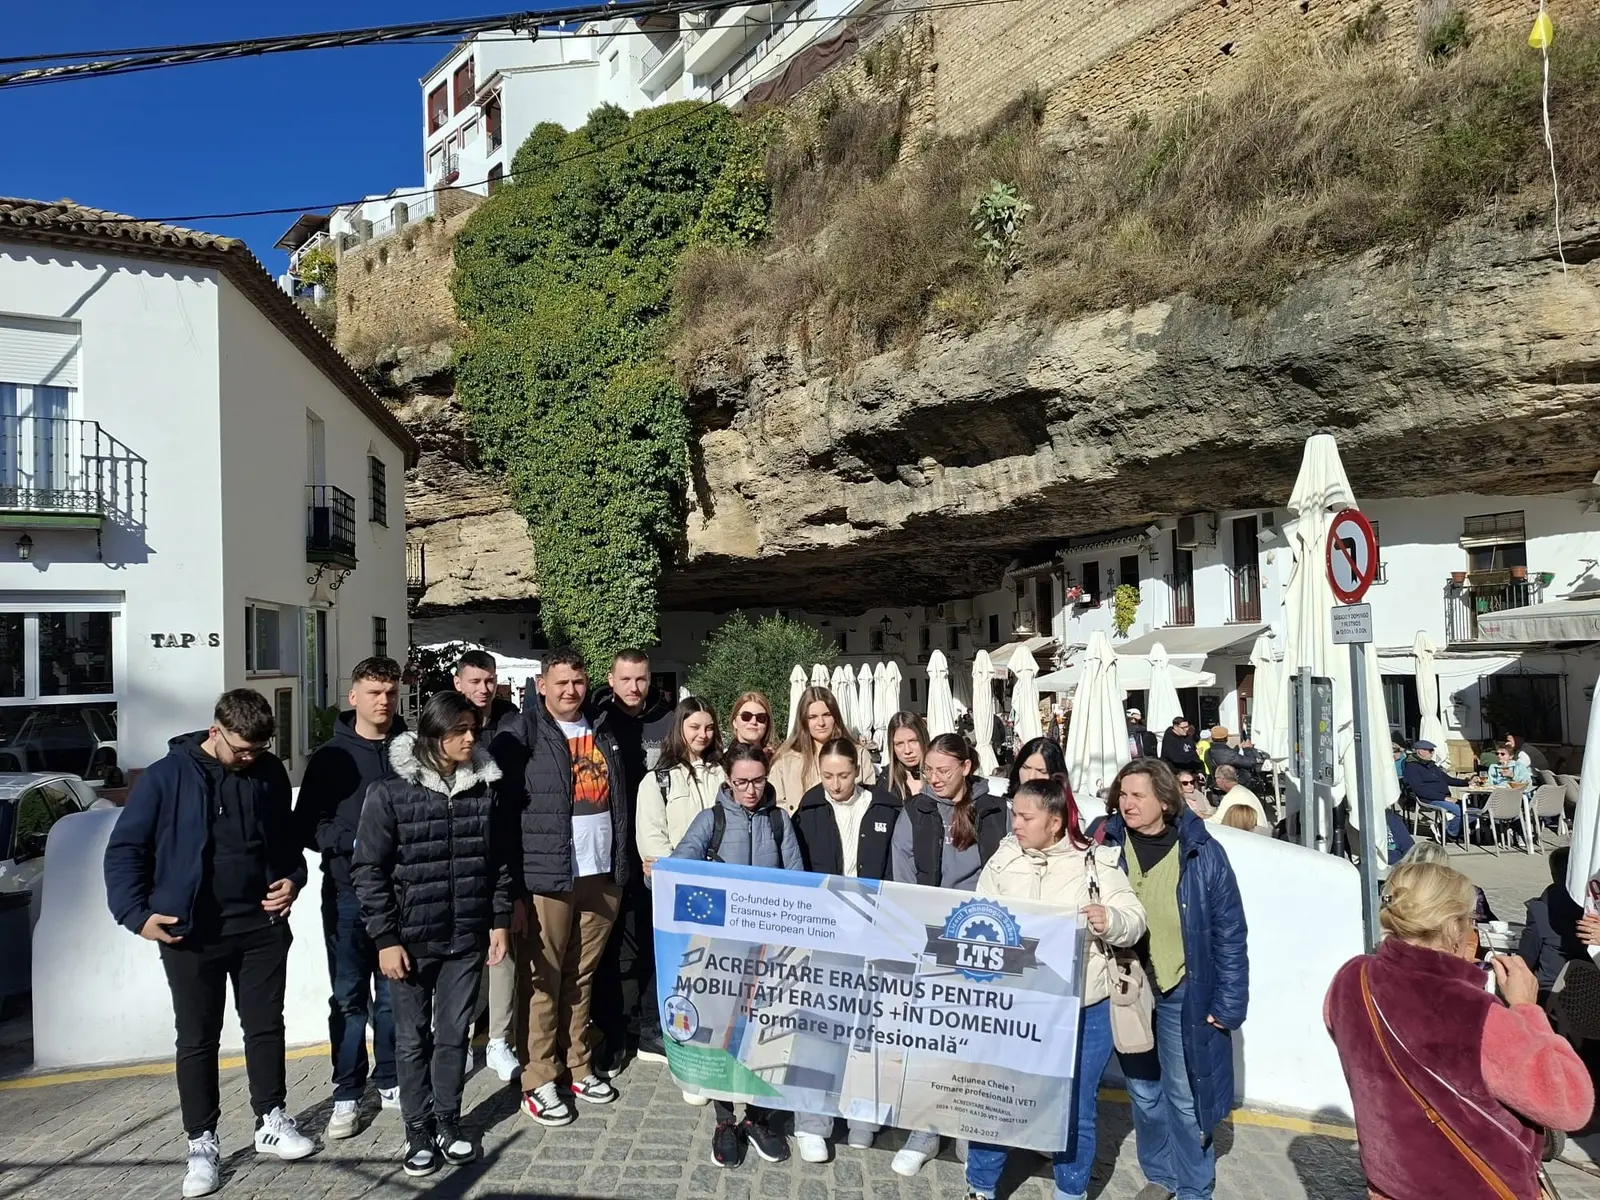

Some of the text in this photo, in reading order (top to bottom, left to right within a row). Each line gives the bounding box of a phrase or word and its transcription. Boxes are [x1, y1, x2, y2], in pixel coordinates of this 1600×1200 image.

[731, 892, 812, 910] Co-funded by the
[731, 904, 837, 926] Erasmus+ Programme
[949, 913, 963, 933] Liceul
[963, 906, 1003, 919] Tehnologic
[729, 918, 836, 939] of the European Union
[956, 943, 1004, 970] LTS
[705, 953, 1014, 1011] ACREDITARE ERASMUS PENTRU
[675, 975, 782, 1008] MOBILITĂȚI
[789, 989, 883, 1018] ERASMUS
[929, 1009, 1042, 1042] DOMENIUL
[931, 1081, 1037, 1108] Formare profesională (VET)
[951, 1074, 1015, 1093] Acțiunea Cheie 1
[953, 1098, 985, 1110] ACREDITARE
[960, 1124, 999, 1138] 2024-2027
